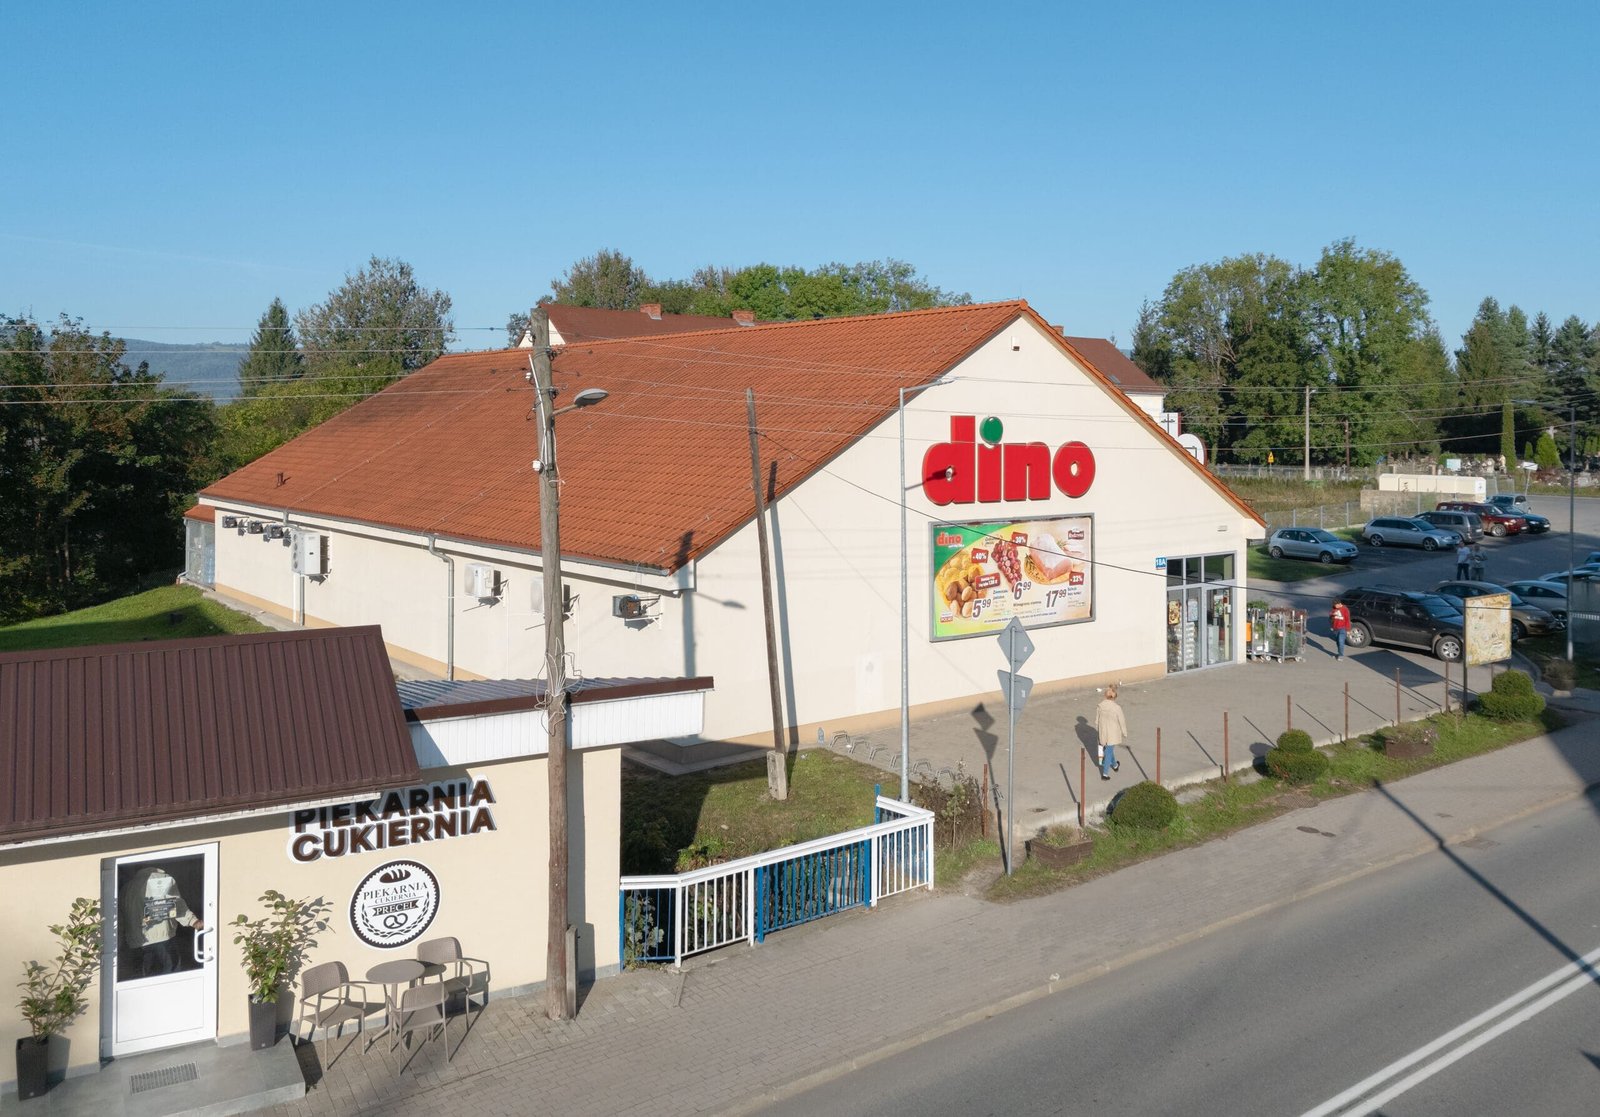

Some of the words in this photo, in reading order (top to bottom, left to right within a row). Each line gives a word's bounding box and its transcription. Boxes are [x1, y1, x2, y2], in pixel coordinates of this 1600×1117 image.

[922, 415, 1096, 507] dino
[936, 531, 963, 546] dino
[294, 779, 496, 834] PIEKARNIA
[292, 807, 497, 862] CUKIERNIA
[363, 881, 428, 900] PIEKARNIA
[374, 892, 417, 905] CUKIERNIA
[376, 901, 416, 916] PRECEL
